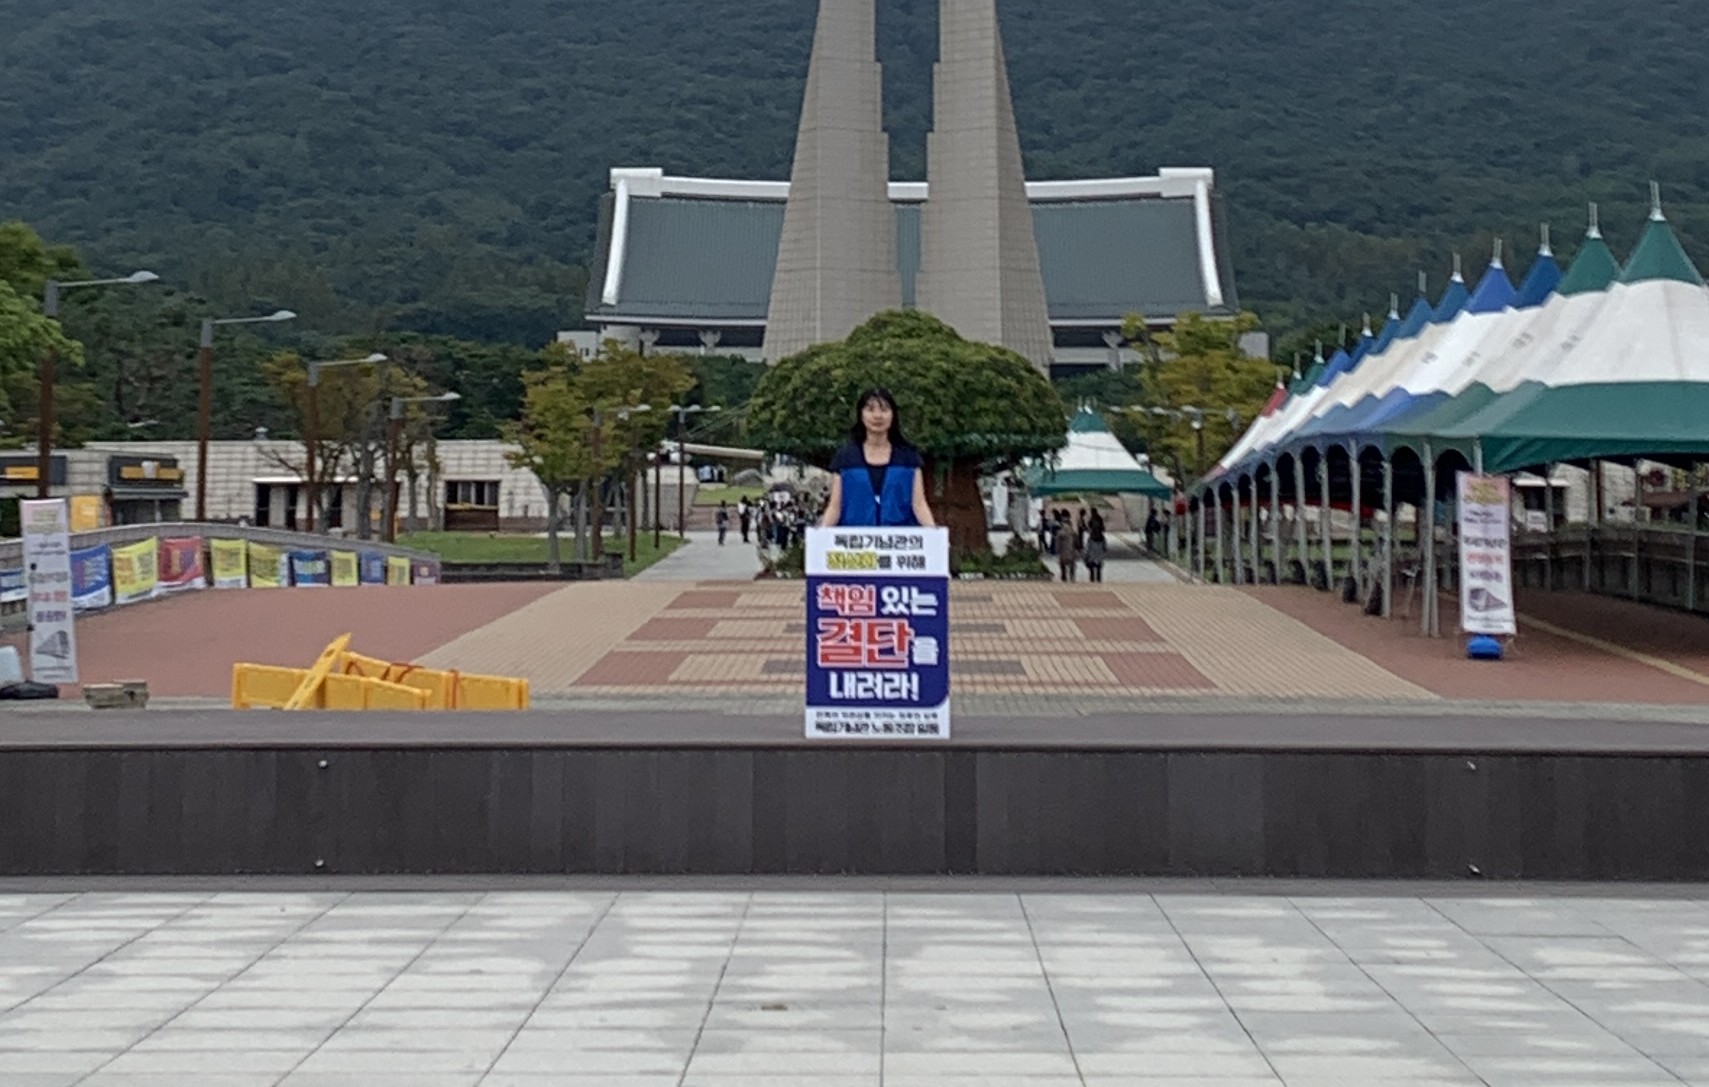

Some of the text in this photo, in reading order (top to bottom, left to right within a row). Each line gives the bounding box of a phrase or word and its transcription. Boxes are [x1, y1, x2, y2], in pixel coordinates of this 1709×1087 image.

[834, 534, 924, 551] 독립기념관의
[896, 555, 927, 571] 위해
[816, 583, 938, 617] 책임 있는
[828, 671, 920, 702] 내려라!
